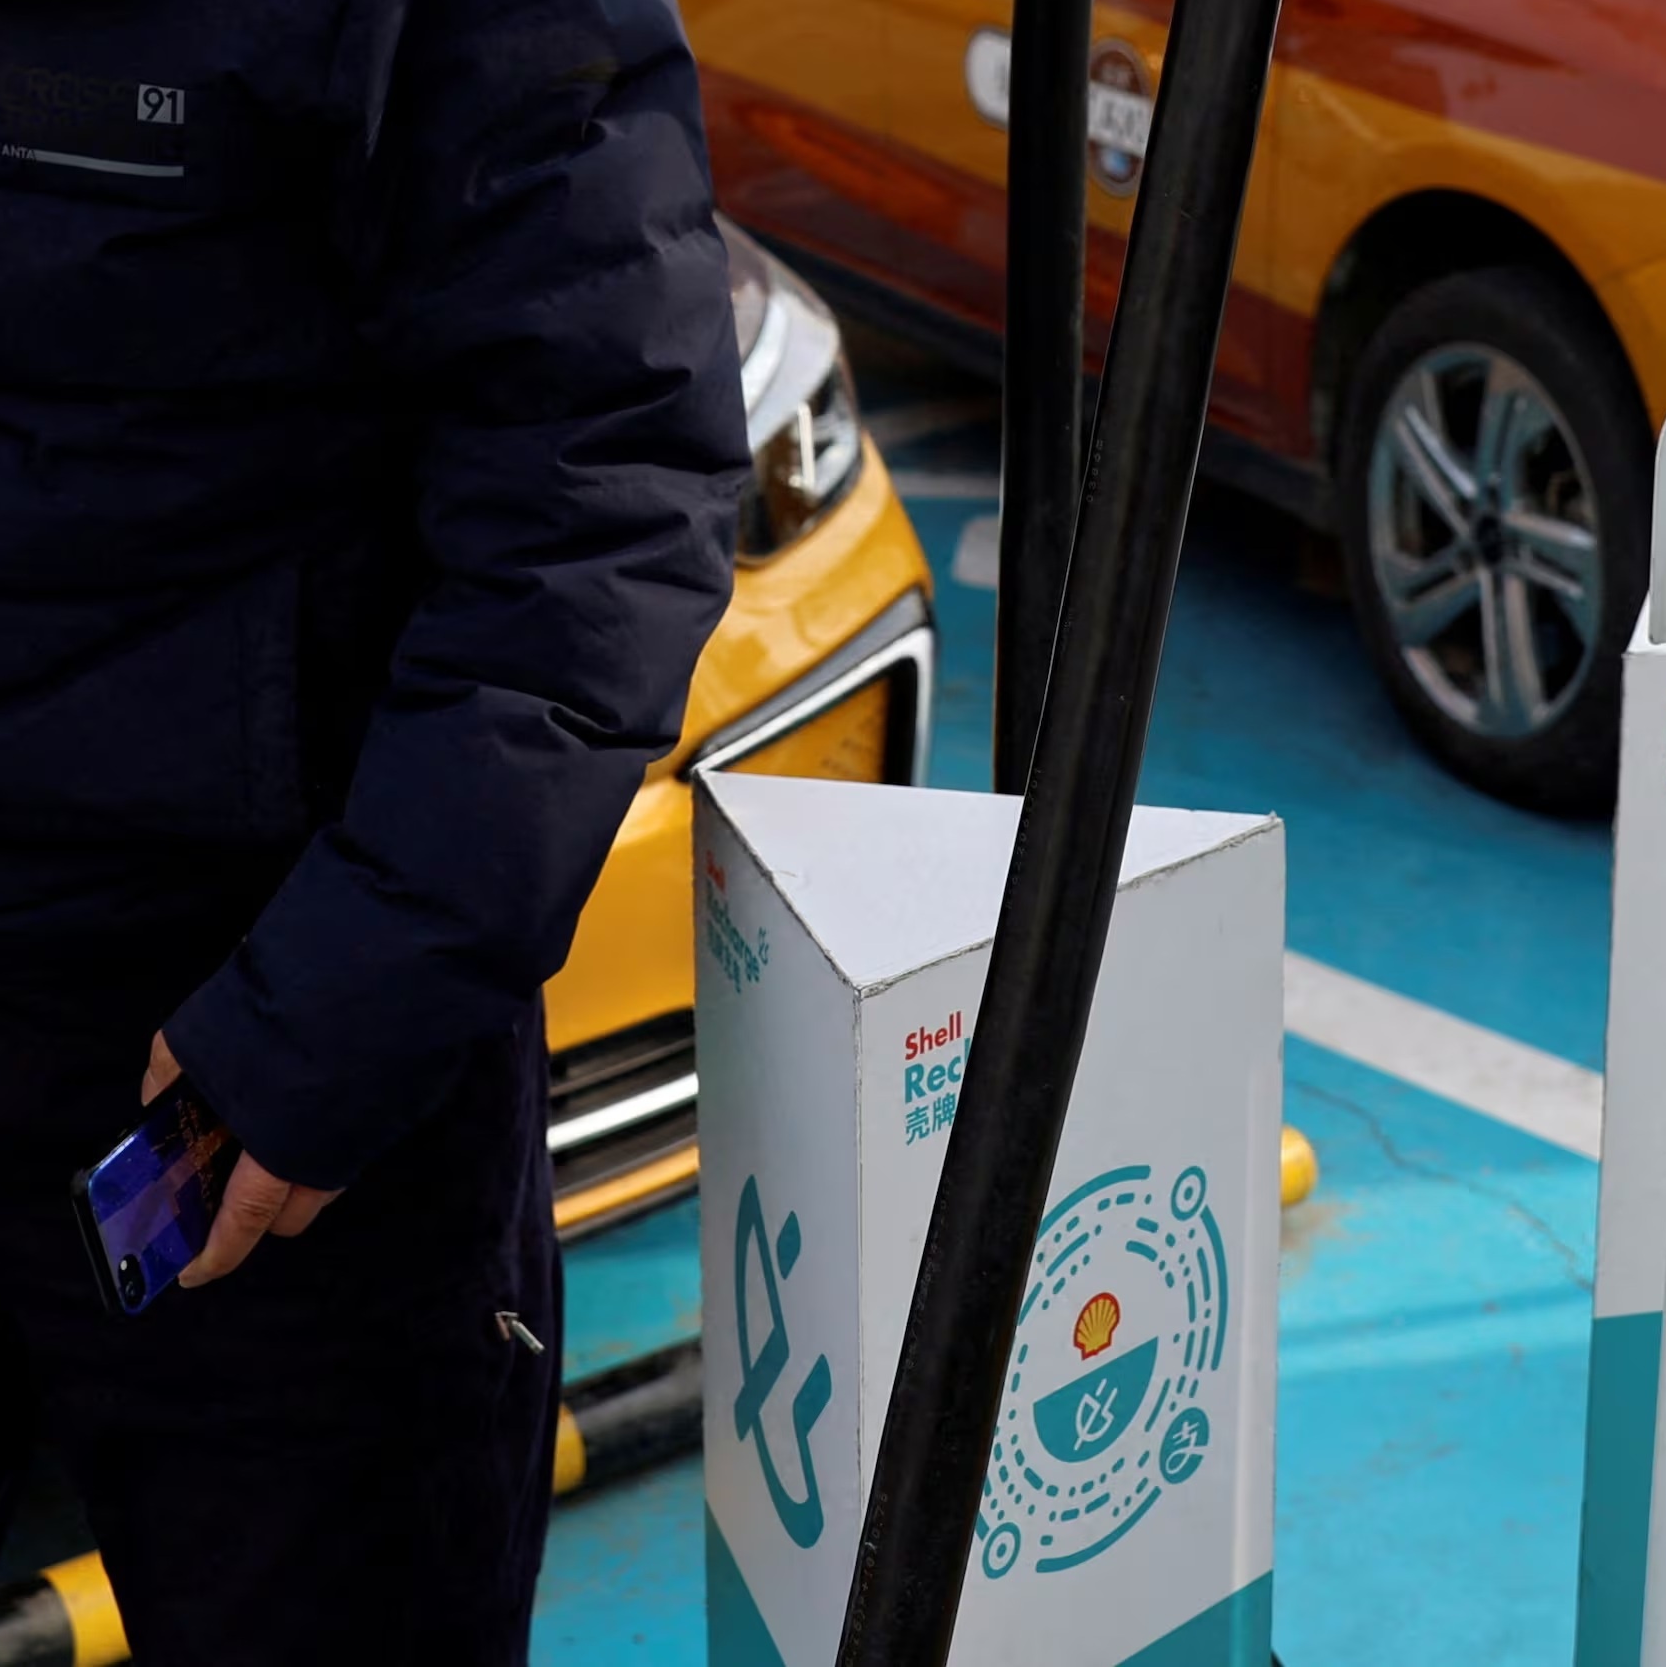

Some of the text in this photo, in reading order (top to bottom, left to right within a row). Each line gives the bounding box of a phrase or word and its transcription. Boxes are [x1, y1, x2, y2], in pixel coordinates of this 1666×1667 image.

[142, 86, 178, 122] 91
[1, 144, 35, 161] ANTA
[904, 1010, 962, 1061] Shell
